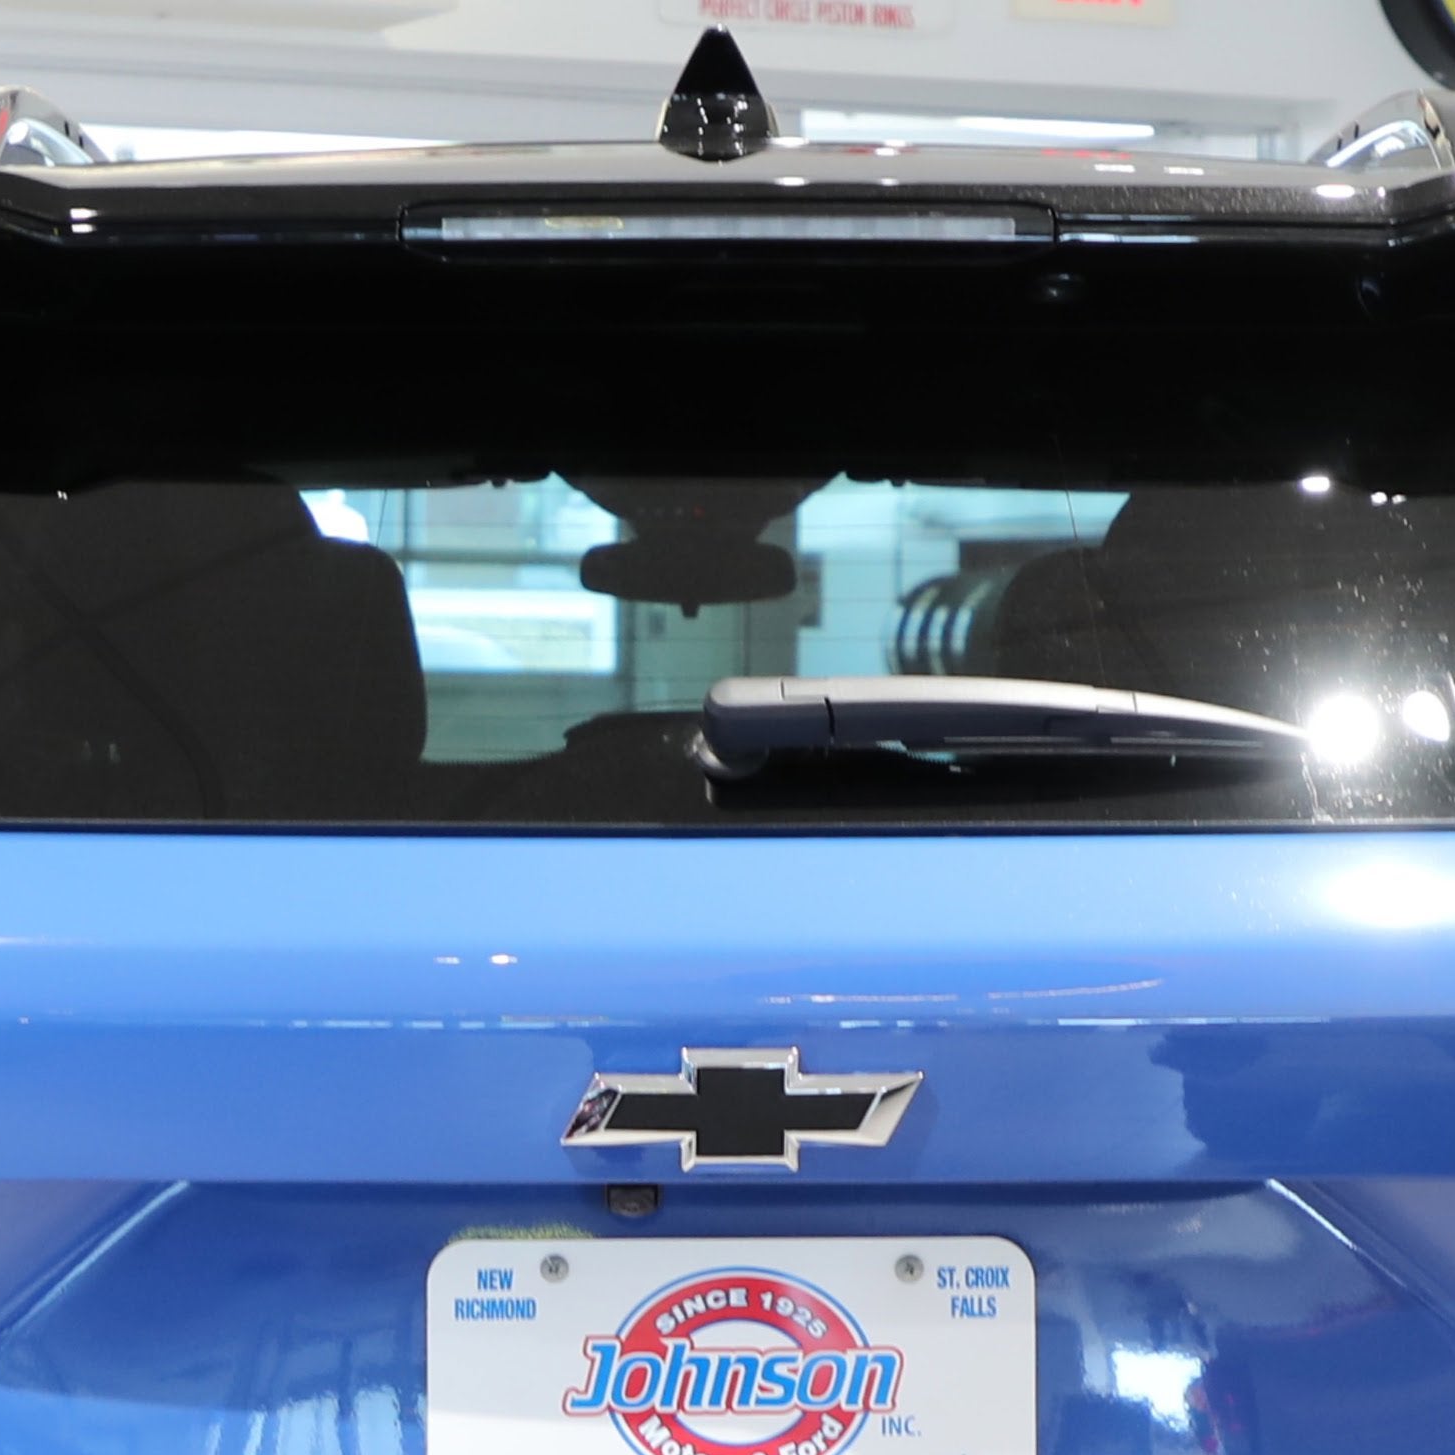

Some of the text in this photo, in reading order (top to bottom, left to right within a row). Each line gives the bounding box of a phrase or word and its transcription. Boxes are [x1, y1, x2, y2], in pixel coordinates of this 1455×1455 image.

[816, 1, 866, 26] PISTON
[872, 3, 913, 29] RINGS
[477, 1268, 514, 1291] NEW
[936, 1266, 1010, 1289] ST. CROIX
[454, 1297, 537, 1321] RICHMOND
[655, 1287, 829, 1340] SINCE 1925
[951, 1295, 997, 1319] FALLS
[567, 1339, 901, 1411] Johnson
[881, 1415, 923, 1437] INC.
